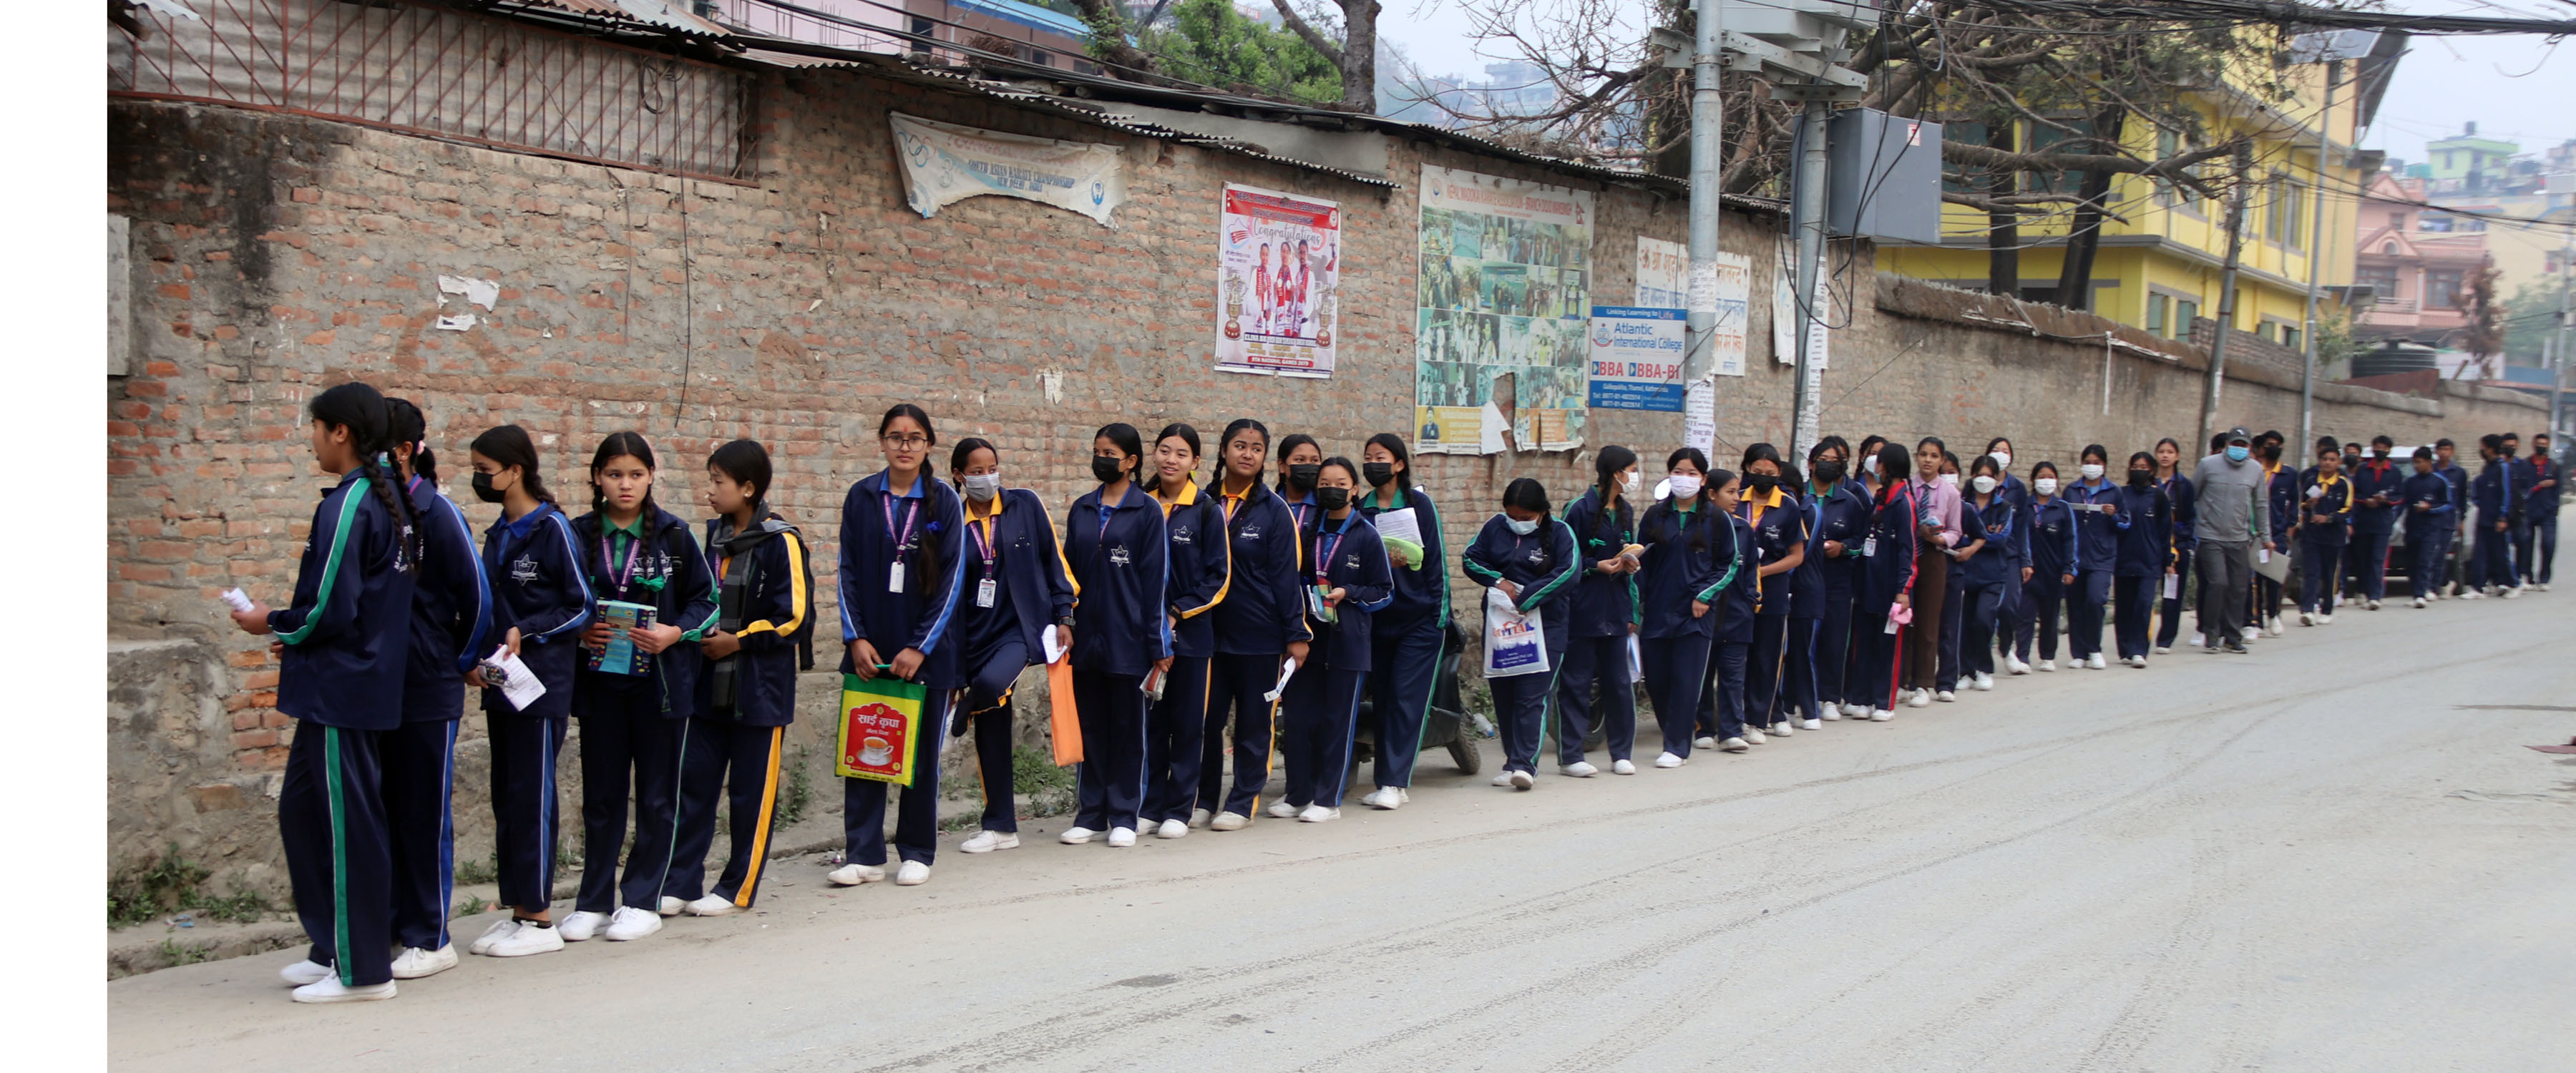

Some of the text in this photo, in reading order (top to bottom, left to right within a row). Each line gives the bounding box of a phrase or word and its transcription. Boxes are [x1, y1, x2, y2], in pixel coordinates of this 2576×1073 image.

[968, 159, 988, 174] SOUTH
[990, 163, 1008, 176] ASIAN
[1008, 166, 1031, 181] KARATE
[1236, 192, 1252, 202] NEPAL
[1254, 216, 1320, 246] Congratulations
[1658, 310, 1674, 319] Life
[1614, 322, 1653, 335] Atlantic
[1614, 336, 1683, 353] International College
[1599, 361, 1624, 376] BBA
